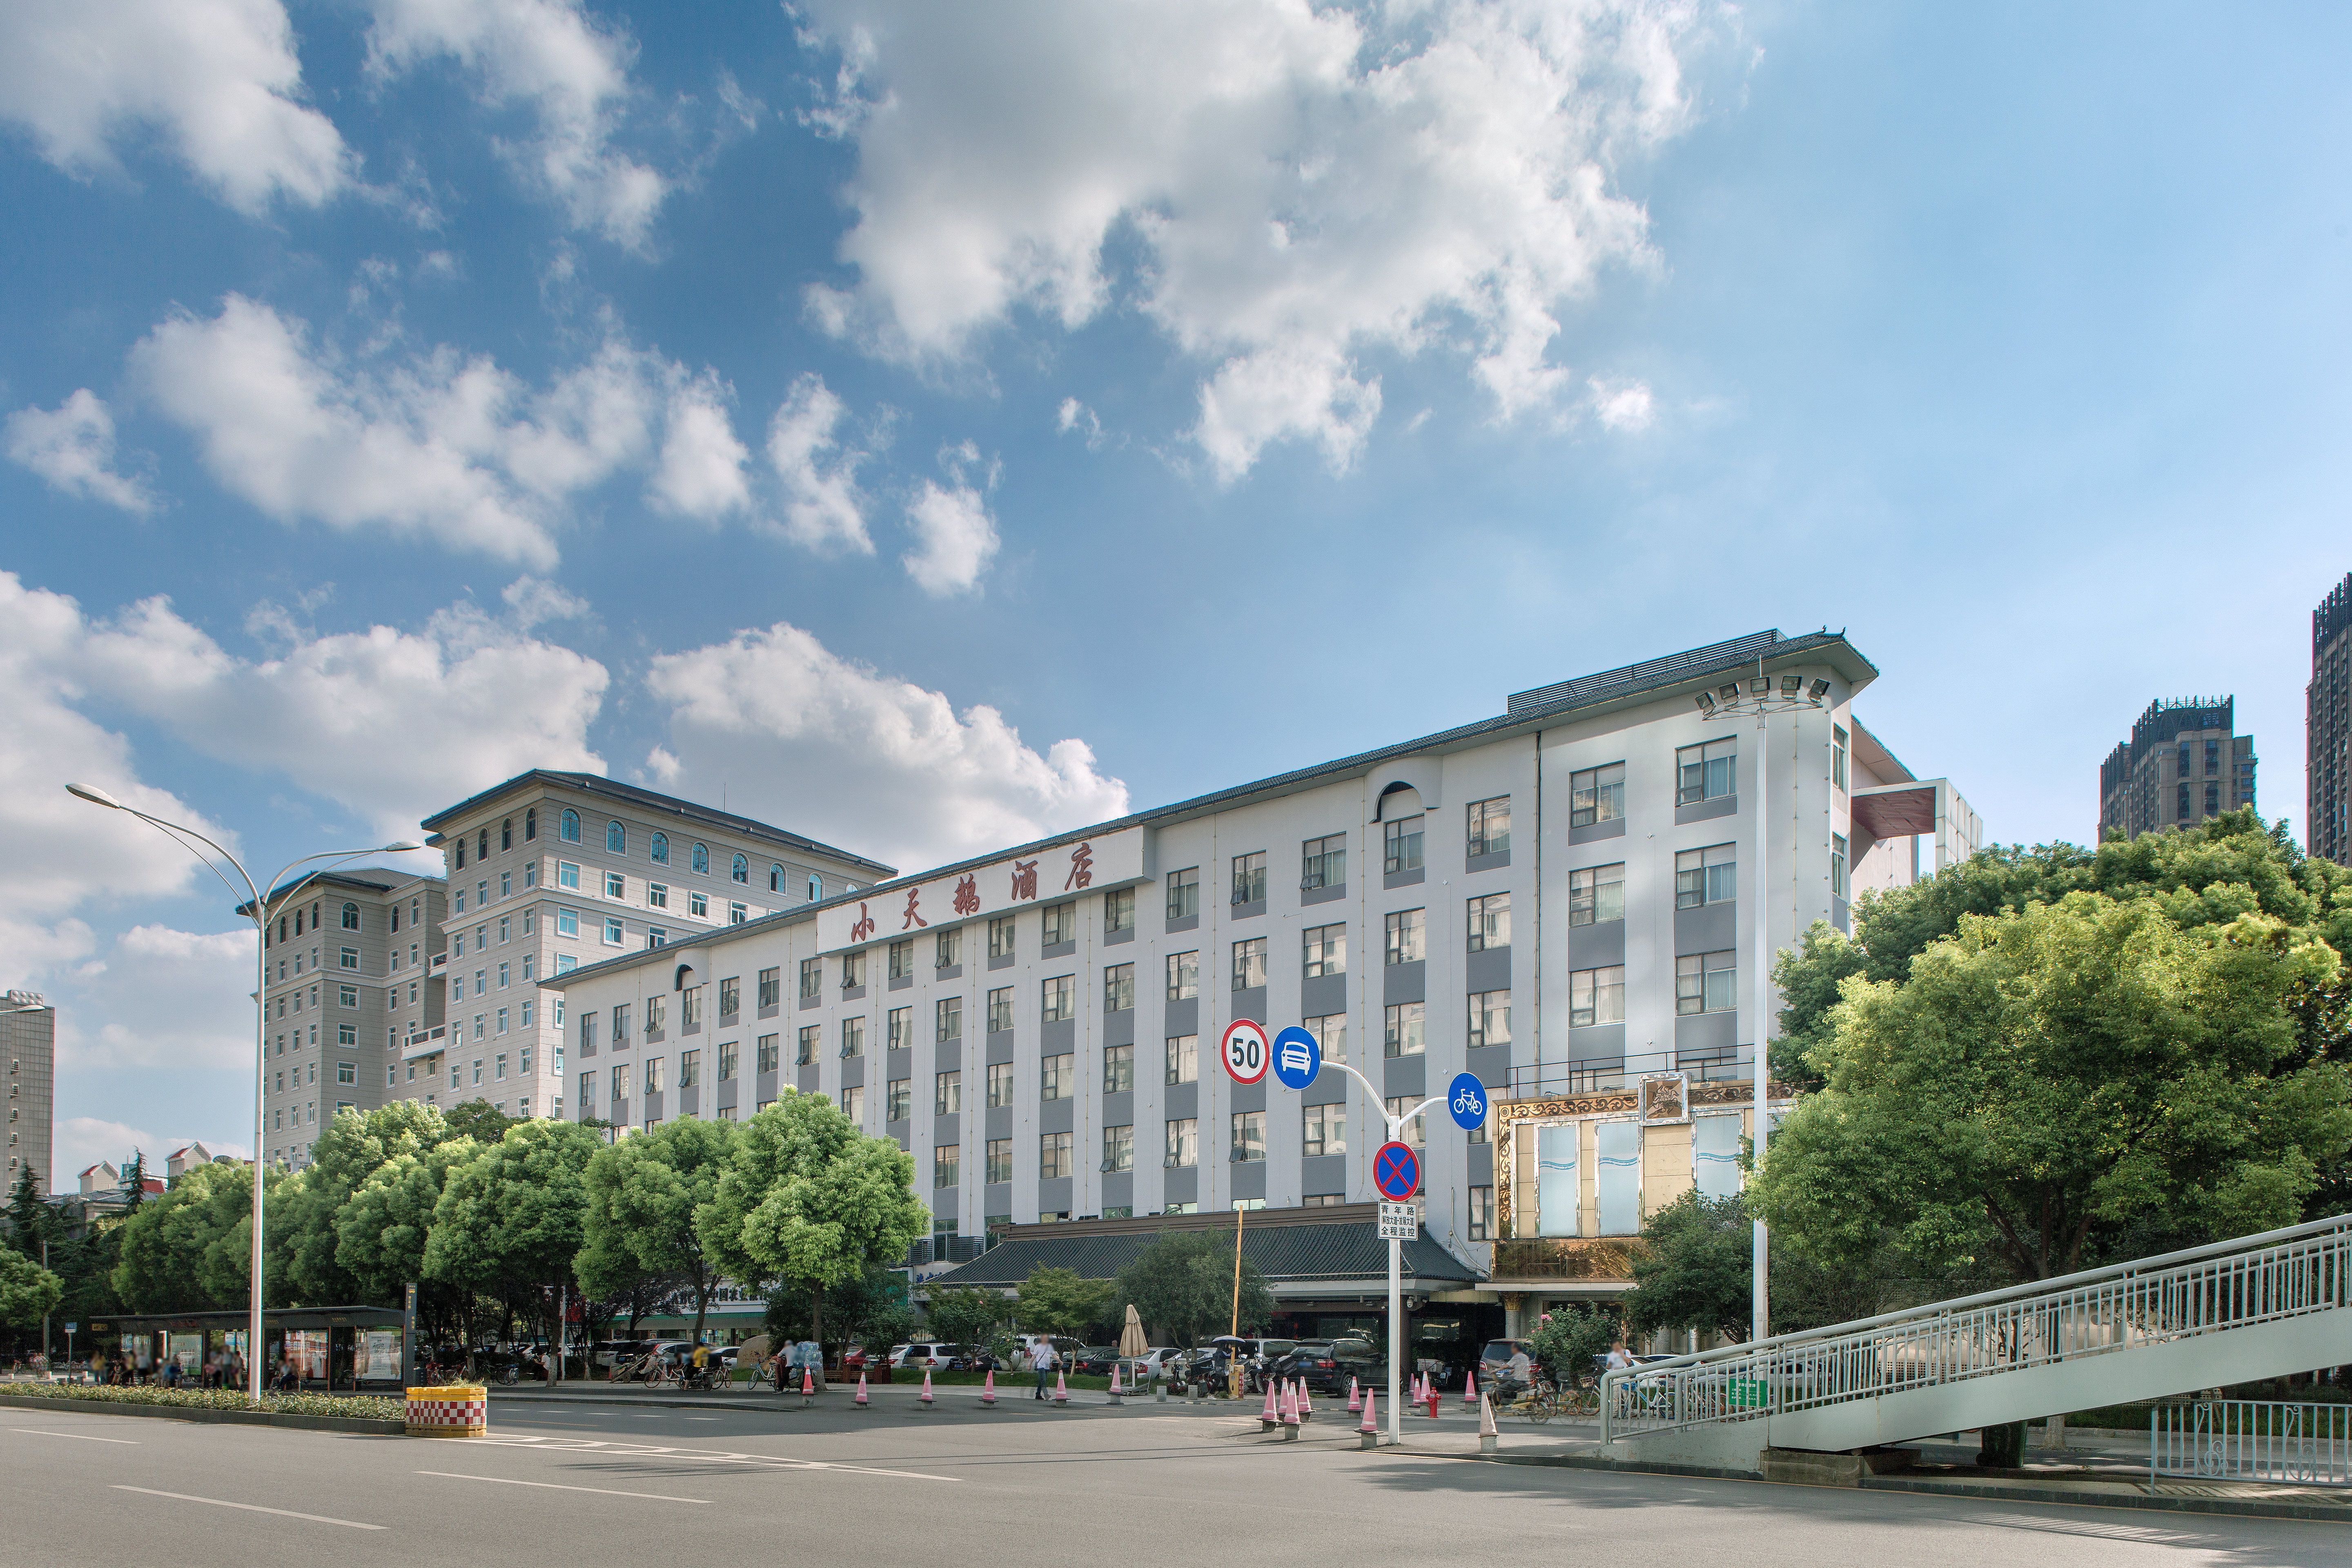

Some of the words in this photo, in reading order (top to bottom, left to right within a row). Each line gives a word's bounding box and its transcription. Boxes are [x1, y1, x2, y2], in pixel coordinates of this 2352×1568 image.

[851, 842, 1093, 942] 小天鹅酒店
[1232, 1038, 1259, 1069] 50
[1381, 1205, 1414, 1216] 青年路
[1381, 1226, 1414, 1237] 全程监控
